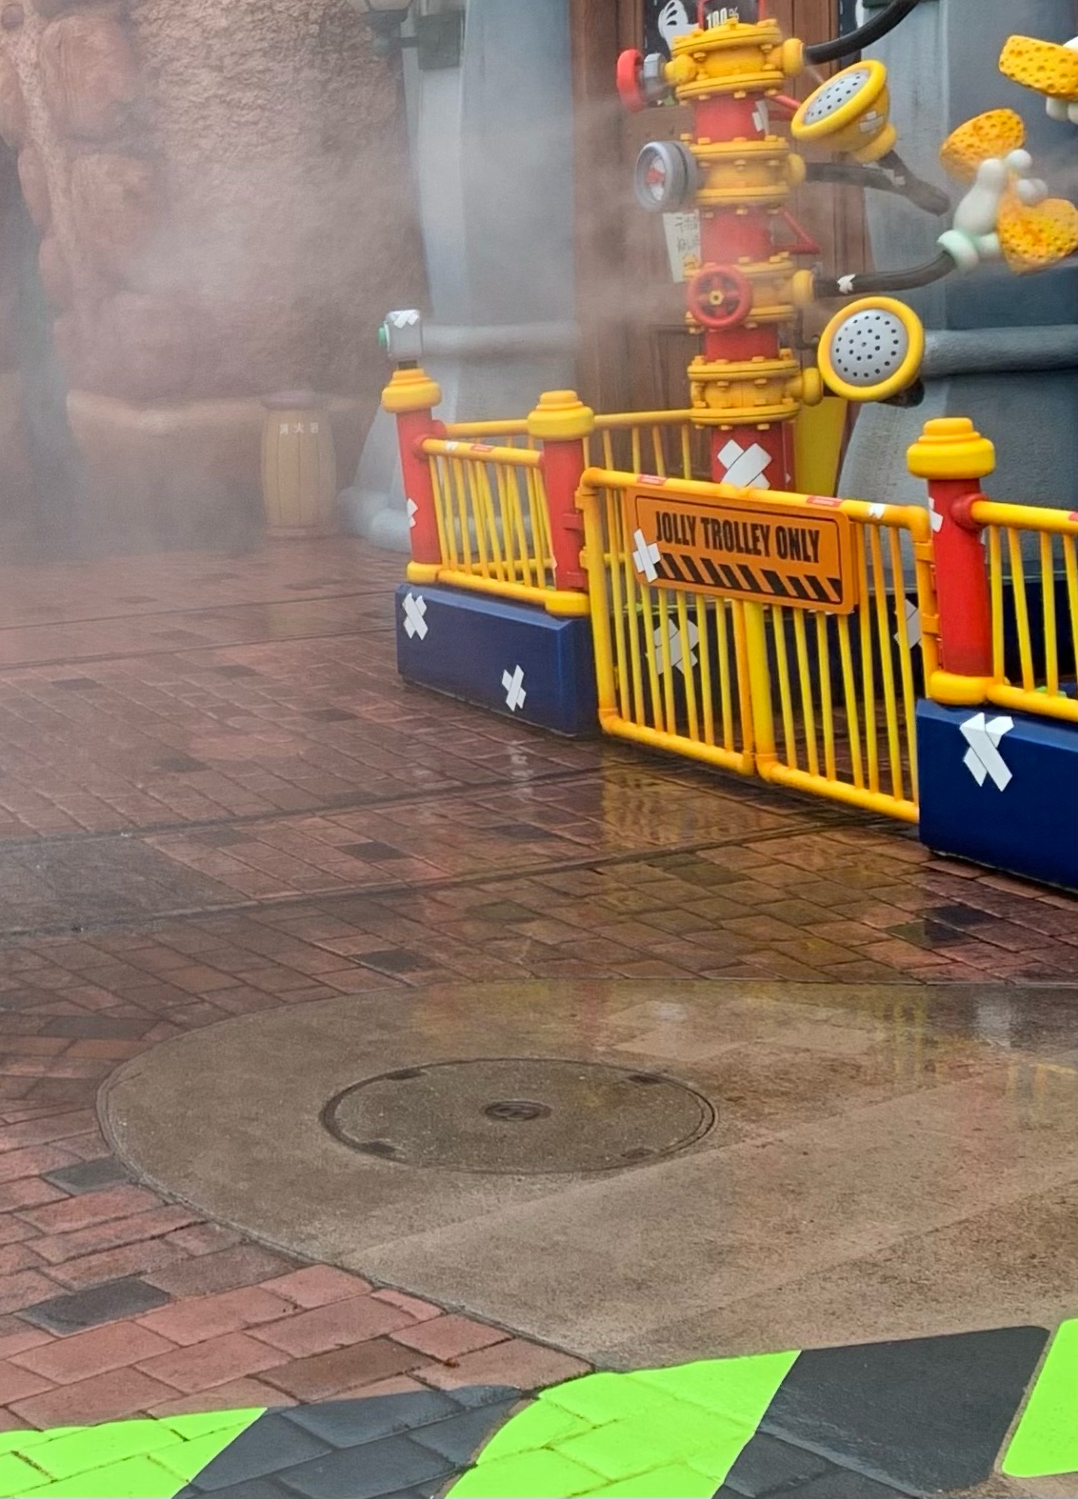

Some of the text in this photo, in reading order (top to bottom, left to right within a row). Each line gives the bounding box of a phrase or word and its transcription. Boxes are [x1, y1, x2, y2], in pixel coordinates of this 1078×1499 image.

[655, 510, 820, 563] JOLLY TROLLEY ONLY
